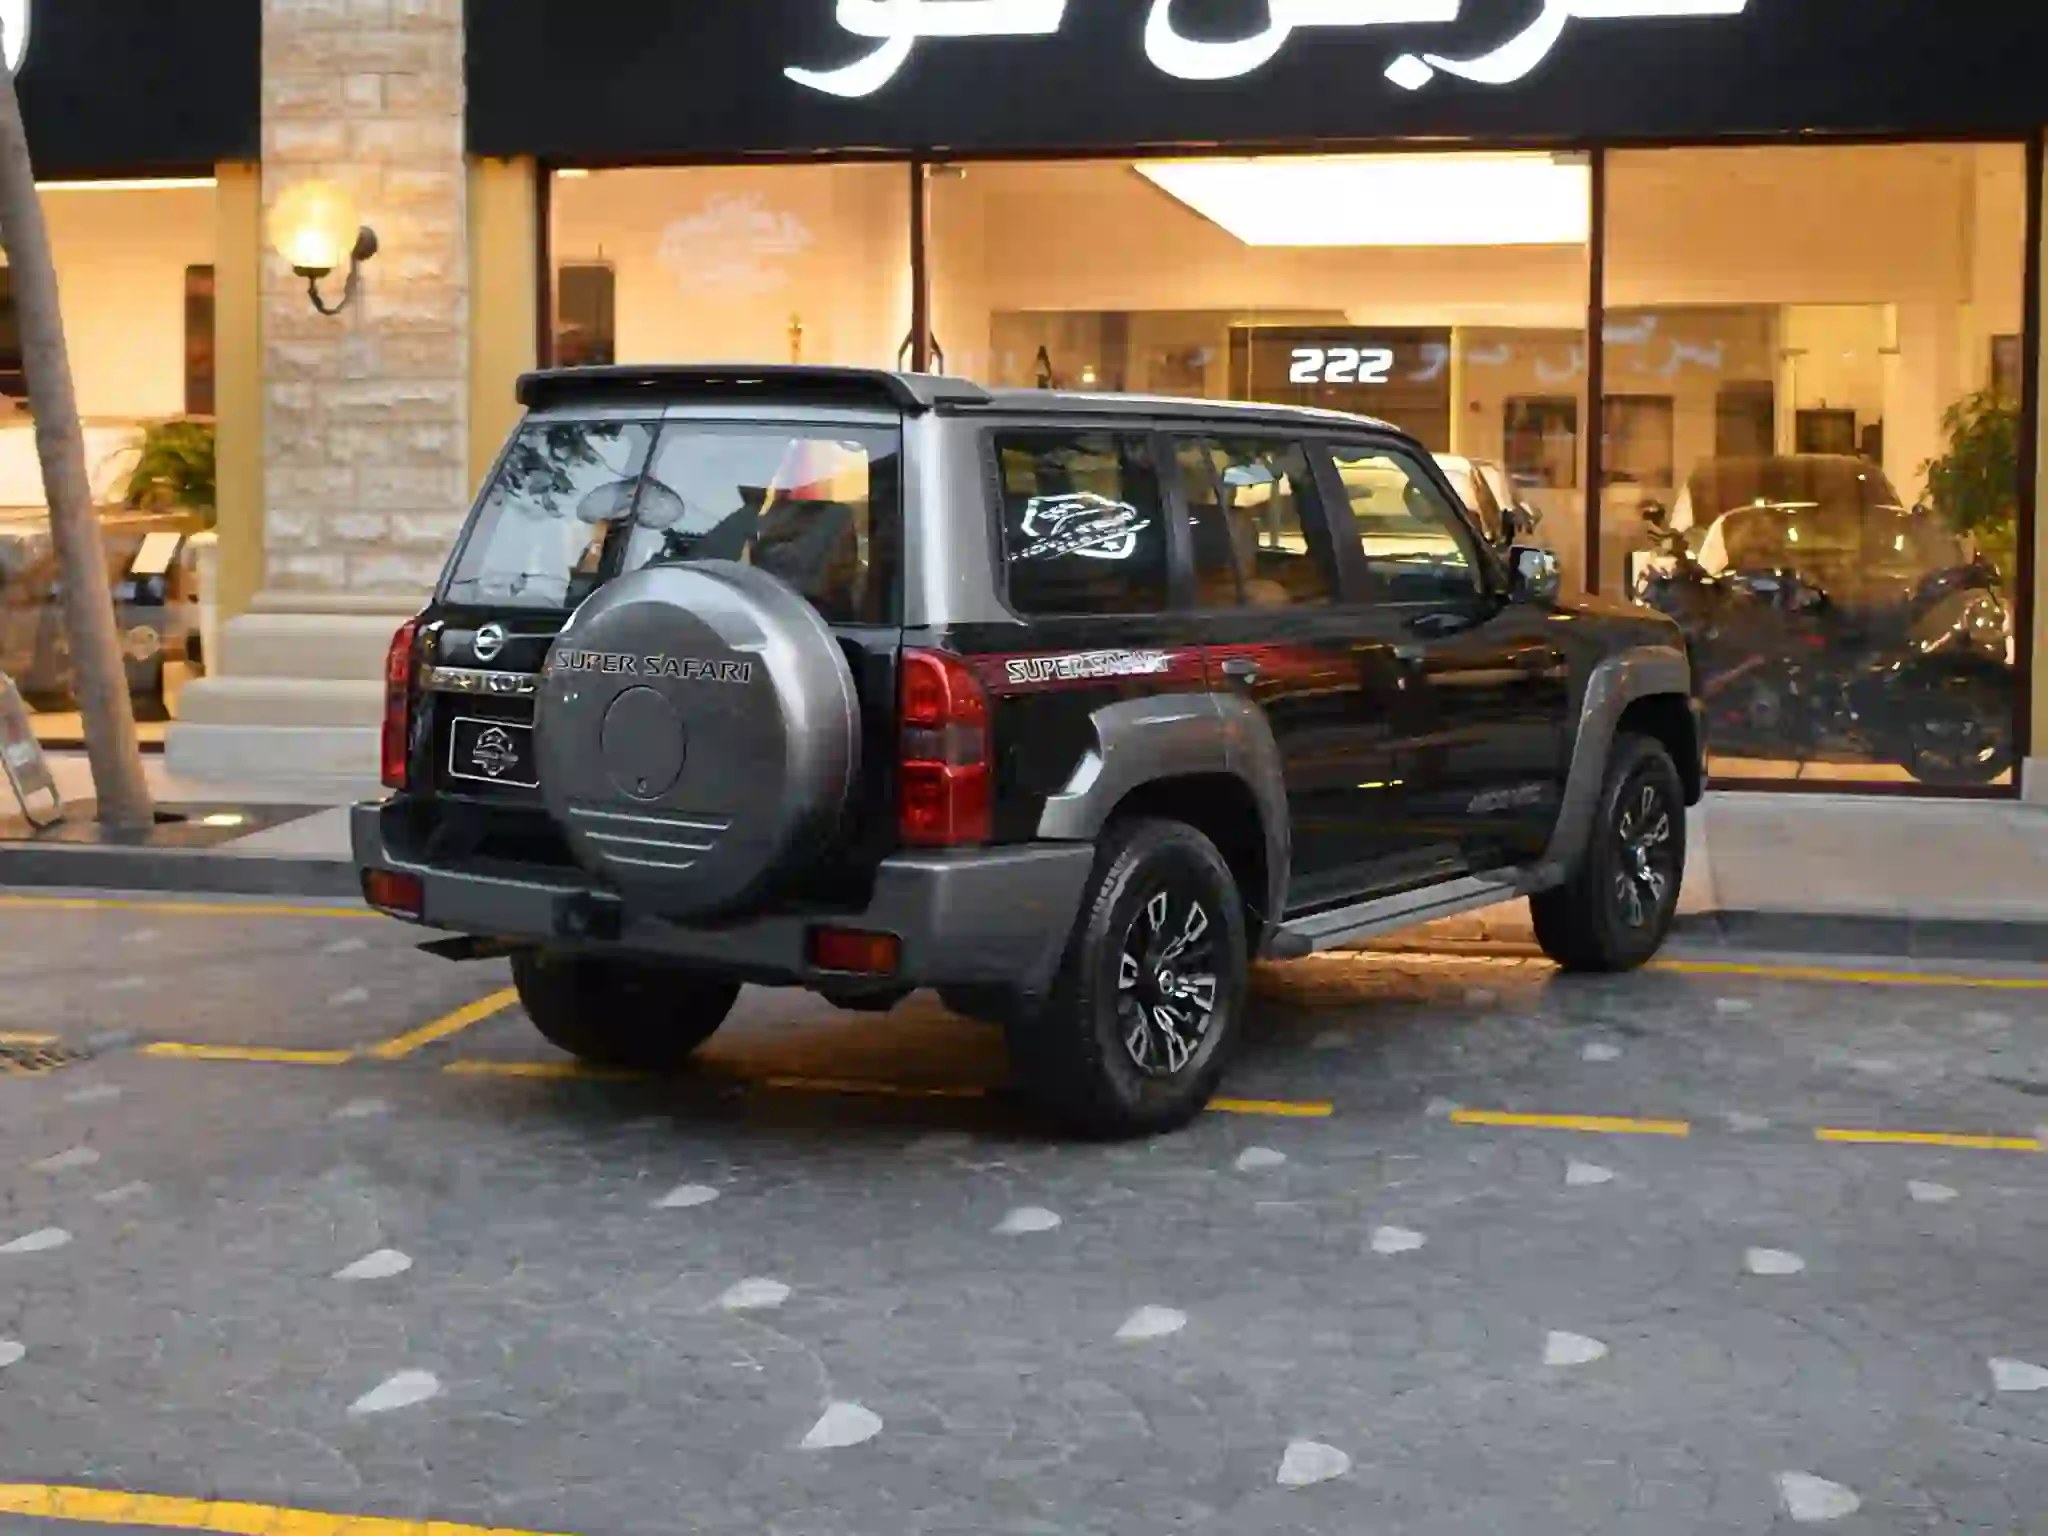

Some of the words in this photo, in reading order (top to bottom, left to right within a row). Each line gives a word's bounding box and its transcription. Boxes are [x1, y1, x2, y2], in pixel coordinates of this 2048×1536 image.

[1289, 347, 1393, 384] 222
[555, 649, 639, 677] SUPER
[643, 652, 752, 684] SAFARI
[1005, 654, 1084, 684] SUPER
